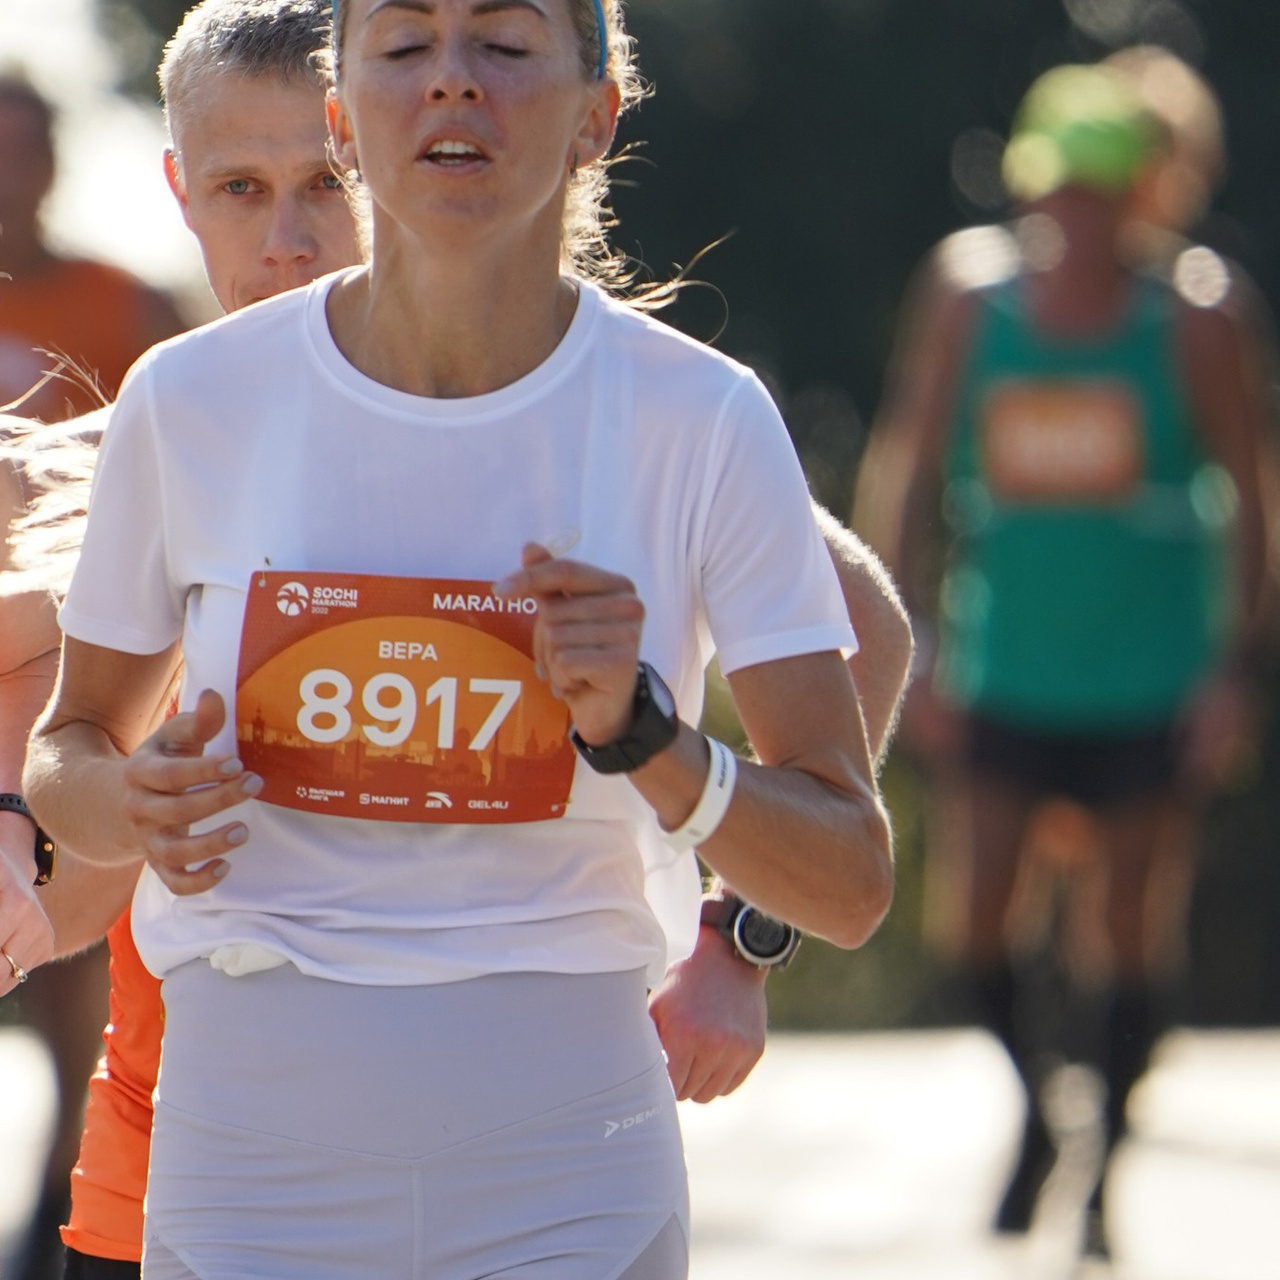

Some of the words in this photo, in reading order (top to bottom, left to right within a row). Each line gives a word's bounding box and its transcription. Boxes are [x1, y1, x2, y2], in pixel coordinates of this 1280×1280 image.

[313, 586, 358, 600] SOCHI
[311, 599, 357, 608] MARATHON
[433, 593, 538, 614] MARATHO
[378, 640, 438, 661] ВЕРА
[296, 668, 523, 751] 8917
[371, 796, 410, 806] МАГНИТ
[468, 799, 509, 809] GEL4U
